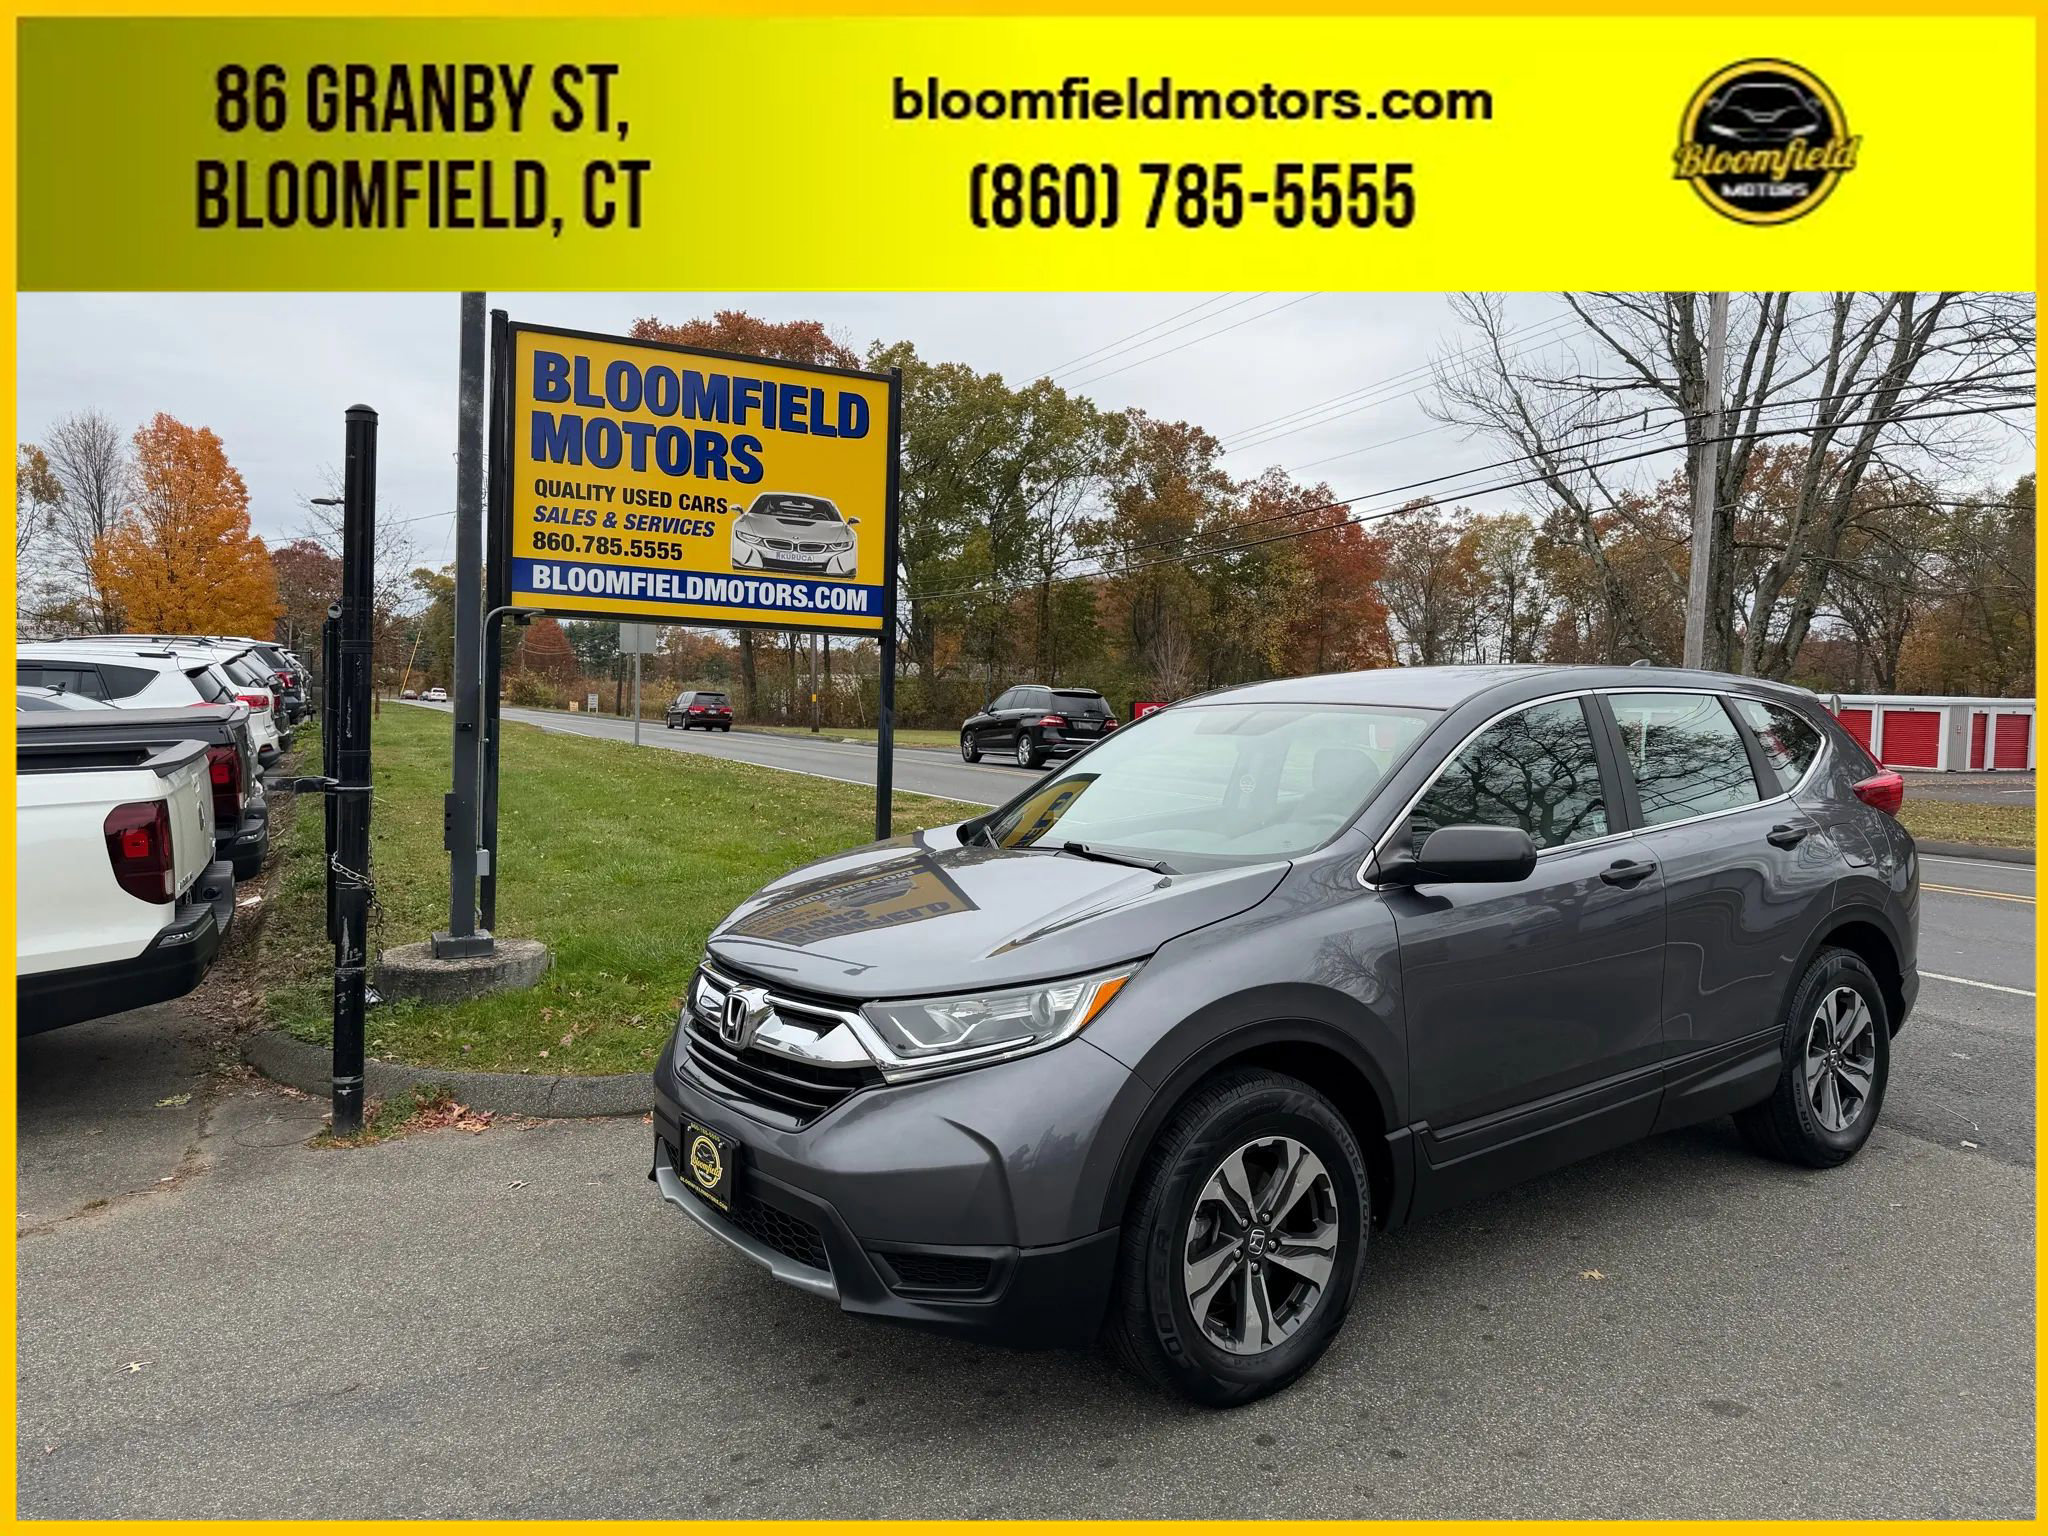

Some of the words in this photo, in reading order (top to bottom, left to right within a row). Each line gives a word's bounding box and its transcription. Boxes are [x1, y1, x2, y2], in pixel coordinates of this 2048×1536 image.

[532, 350, 870, 439] BLOOMFIELD
[530, 410, 765, 484] MOTORS
[534, 478, 616, 503] QUALITY
[622, 487, 672, 508] USED
[678, 493, 728, 514] CARS
[533, 505, 597, 526] SALES
[602, 511, 618, 529] &
[623, 514, 715, 538] SERVICES
[532, 531, 683, 561] 860.785.5555
[532, 564, 868, 612] BLOOMFIELDMOTORS.COM
